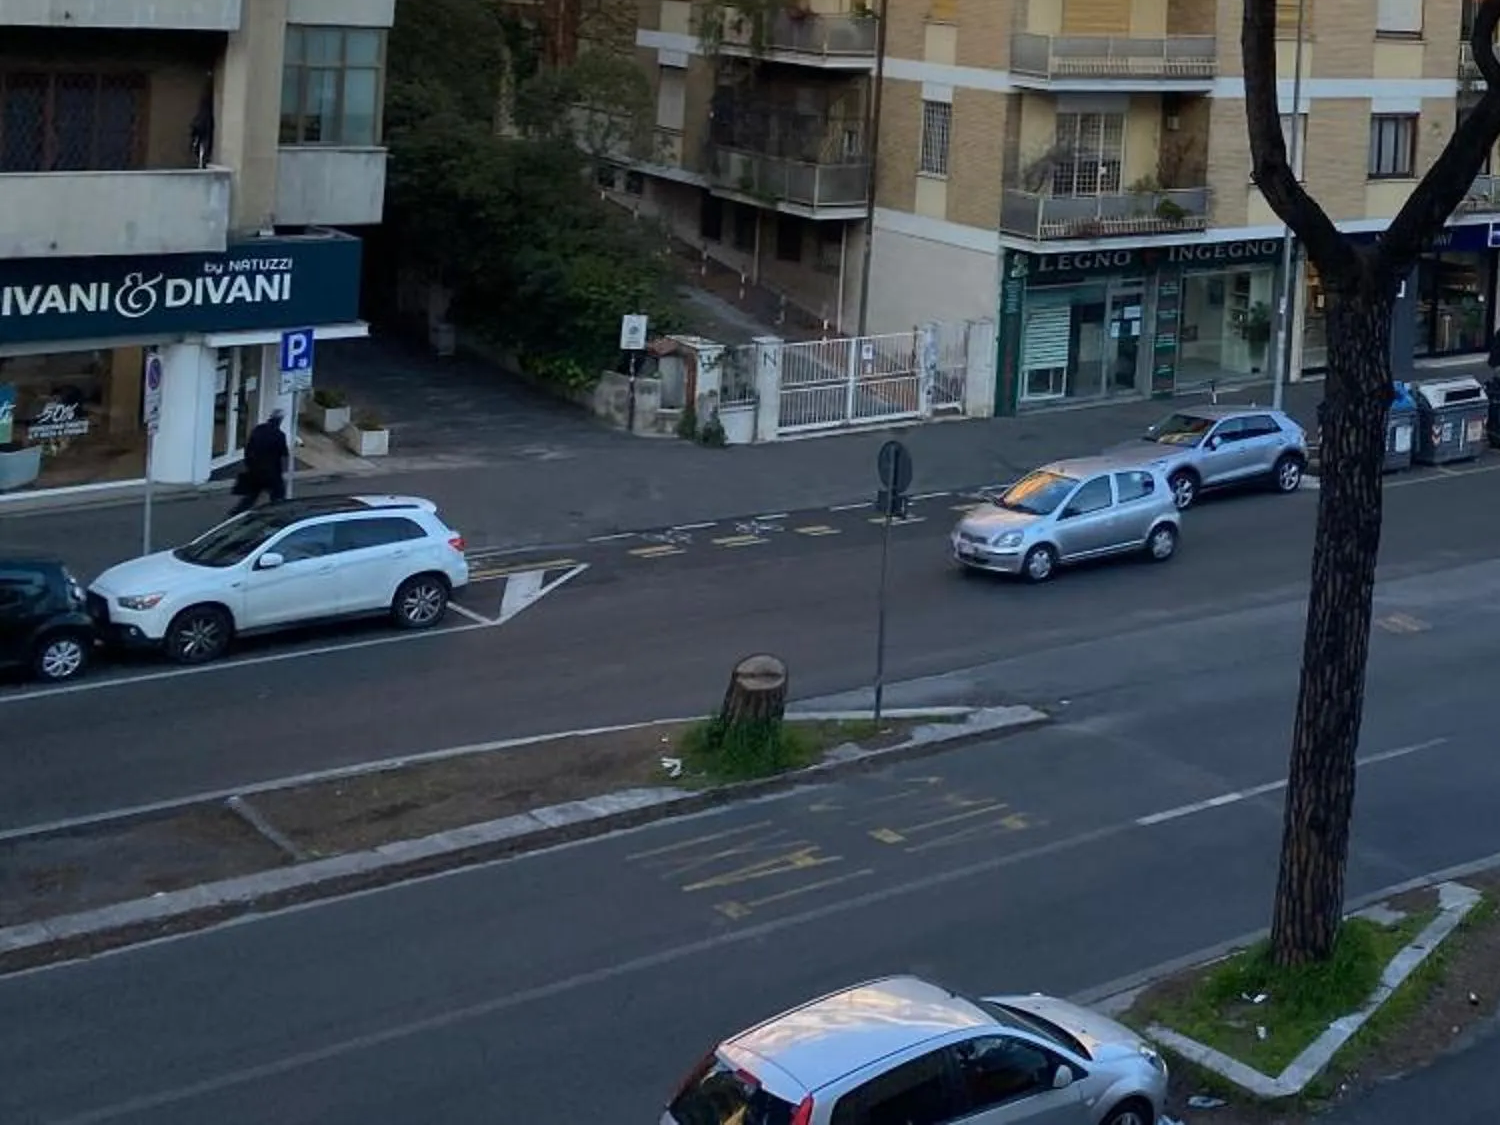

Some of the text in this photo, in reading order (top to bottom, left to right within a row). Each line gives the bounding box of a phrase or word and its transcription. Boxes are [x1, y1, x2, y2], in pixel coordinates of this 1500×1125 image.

[204, 257, 293, 275] by NATUZZI
[1038, 250, 1132, 273] LEGNO
[1168, 239, 1278, 263] INGEGNO
[114, 272, 163, 318] &
[165, 273, 292, 308] DIVANI
[287, 333, 307, 368] P
